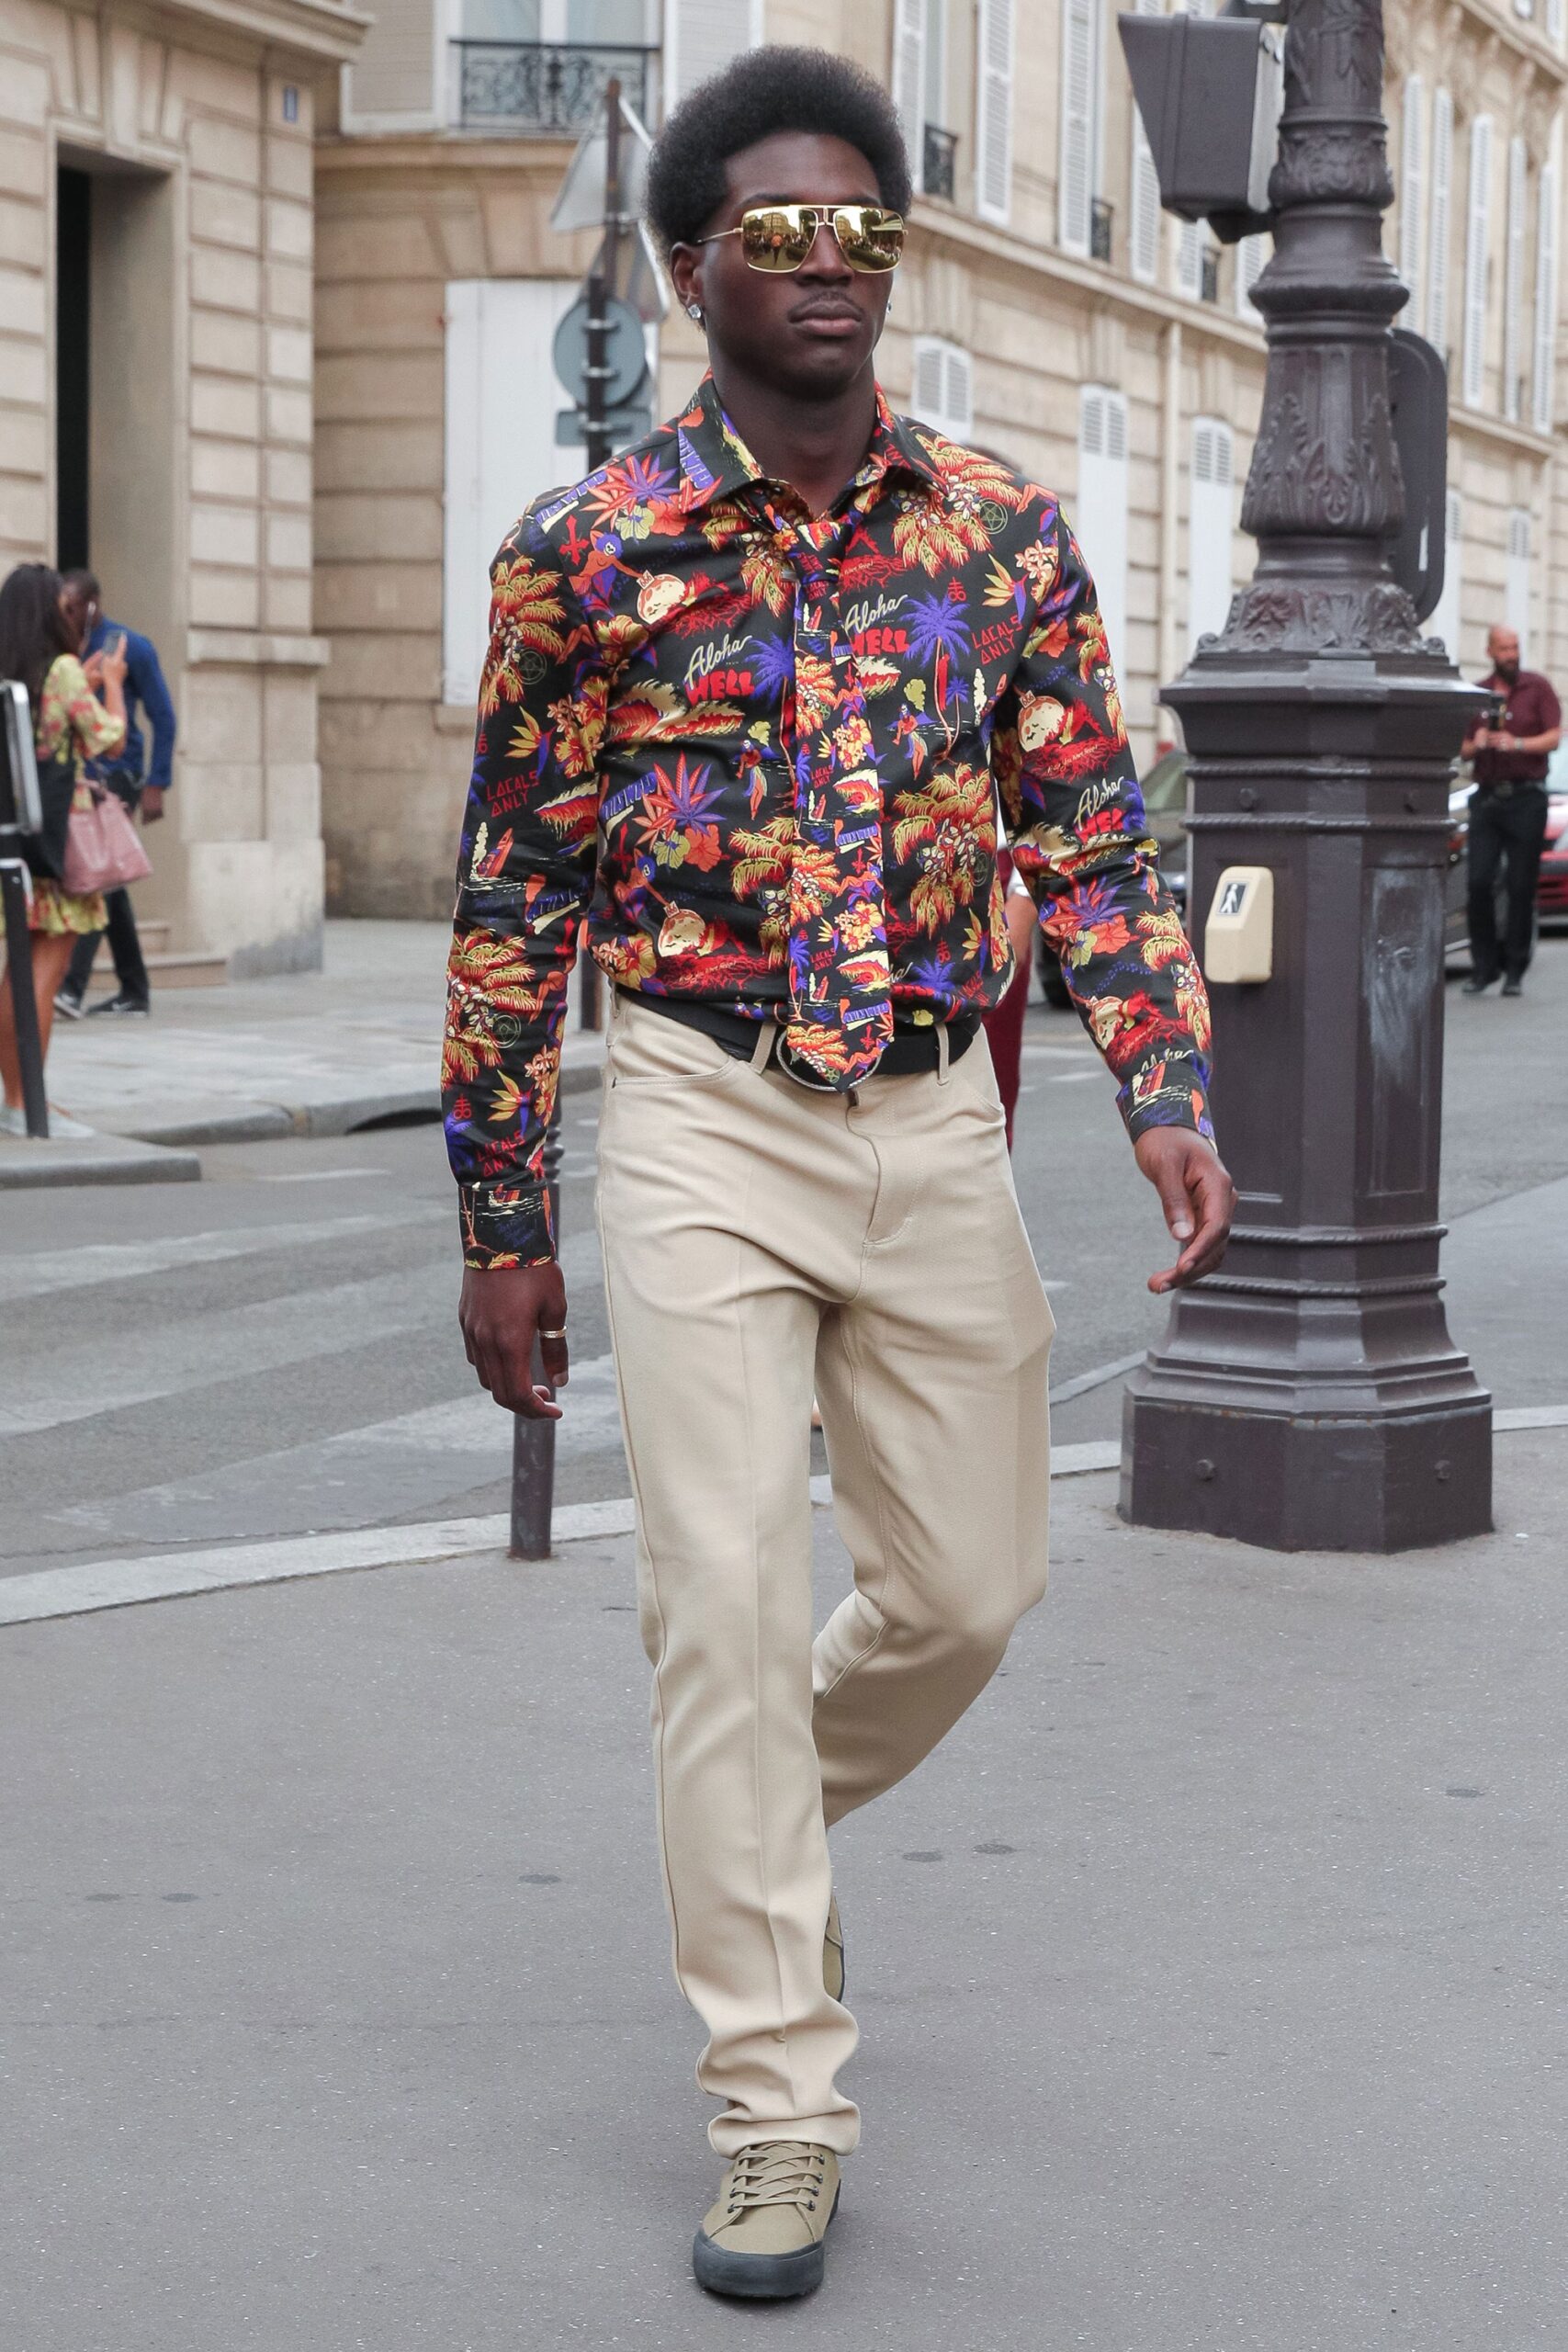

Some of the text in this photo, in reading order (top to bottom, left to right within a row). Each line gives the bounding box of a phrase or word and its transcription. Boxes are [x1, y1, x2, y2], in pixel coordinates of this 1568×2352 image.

[842, 593, 908, 636] Aloha
[683, 633, 753, 691] Aloha
[1073, 776, 1124, 831] Aloha
